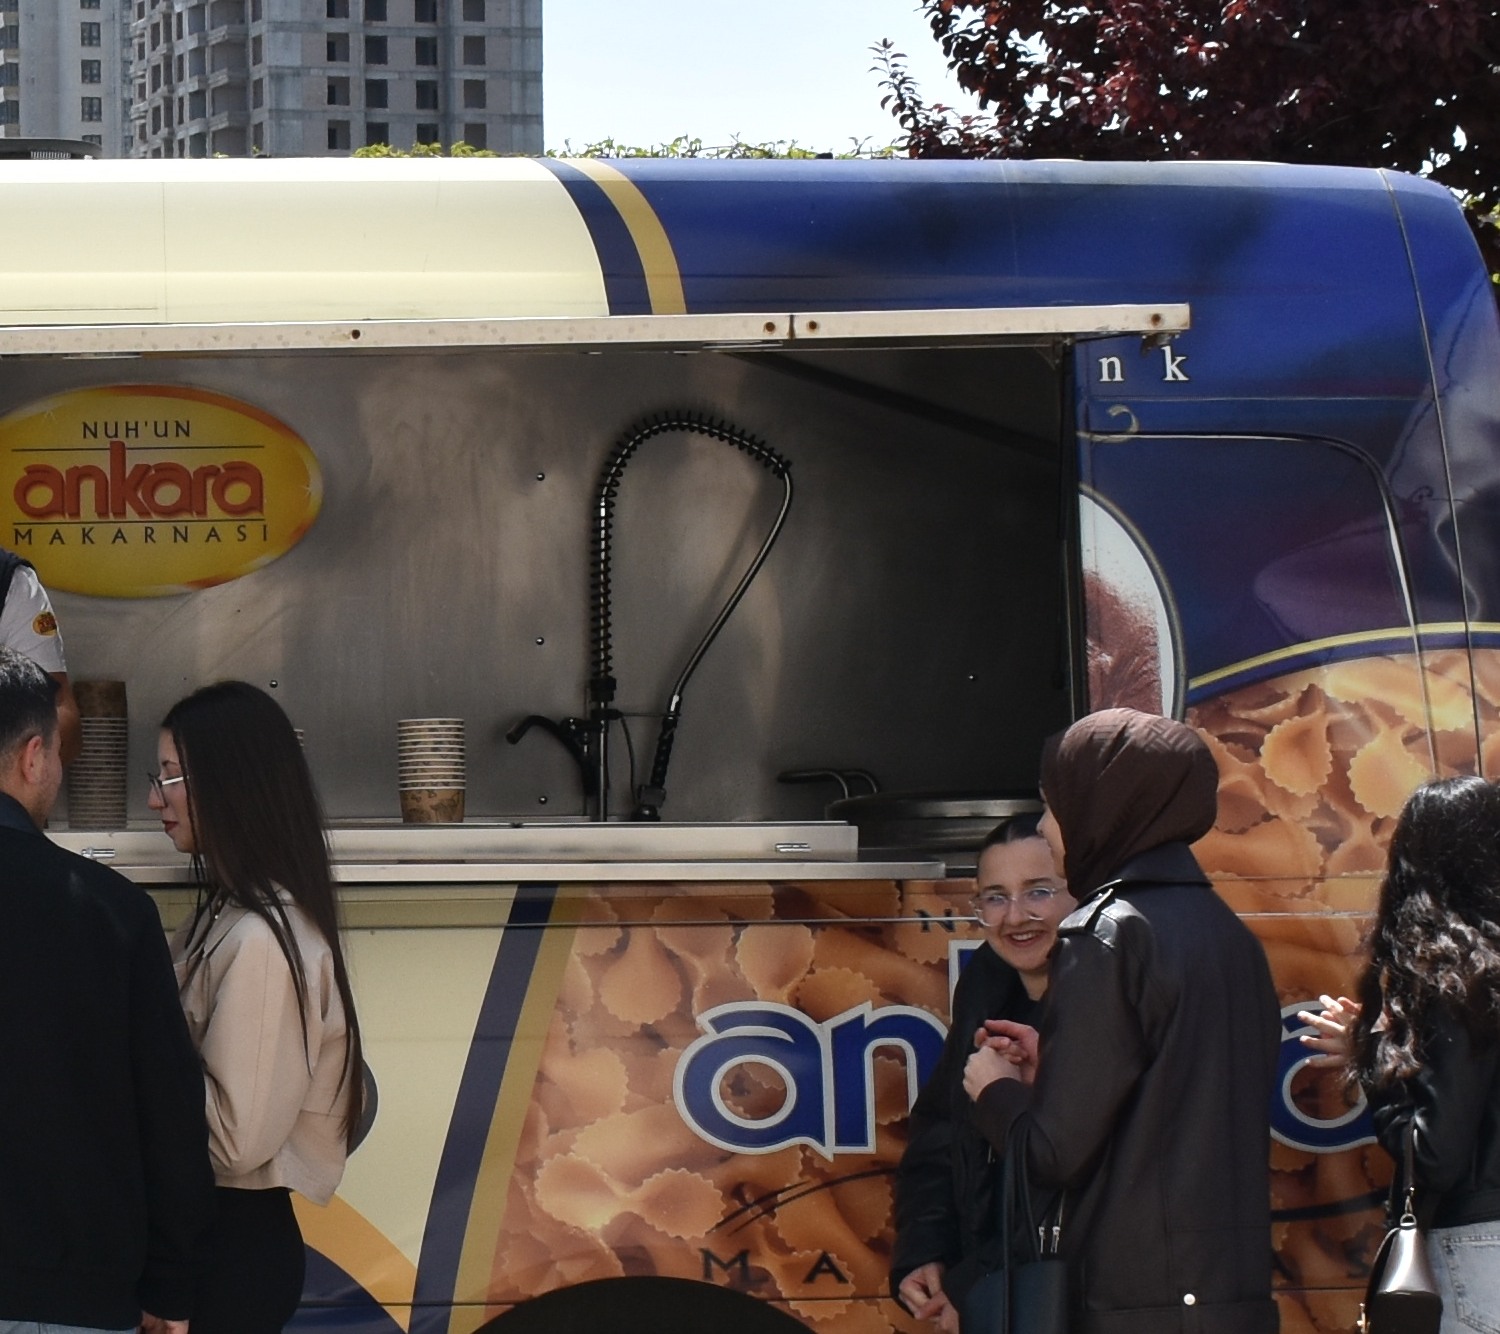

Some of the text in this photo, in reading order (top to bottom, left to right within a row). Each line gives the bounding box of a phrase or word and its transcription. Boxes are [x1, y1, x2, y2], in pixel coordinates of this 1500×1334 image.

[82, 420, 191, 439] NUH'UN
[13, 440, 265, 520] ankara
[14, 524, 268, 546] MAKARNASI
